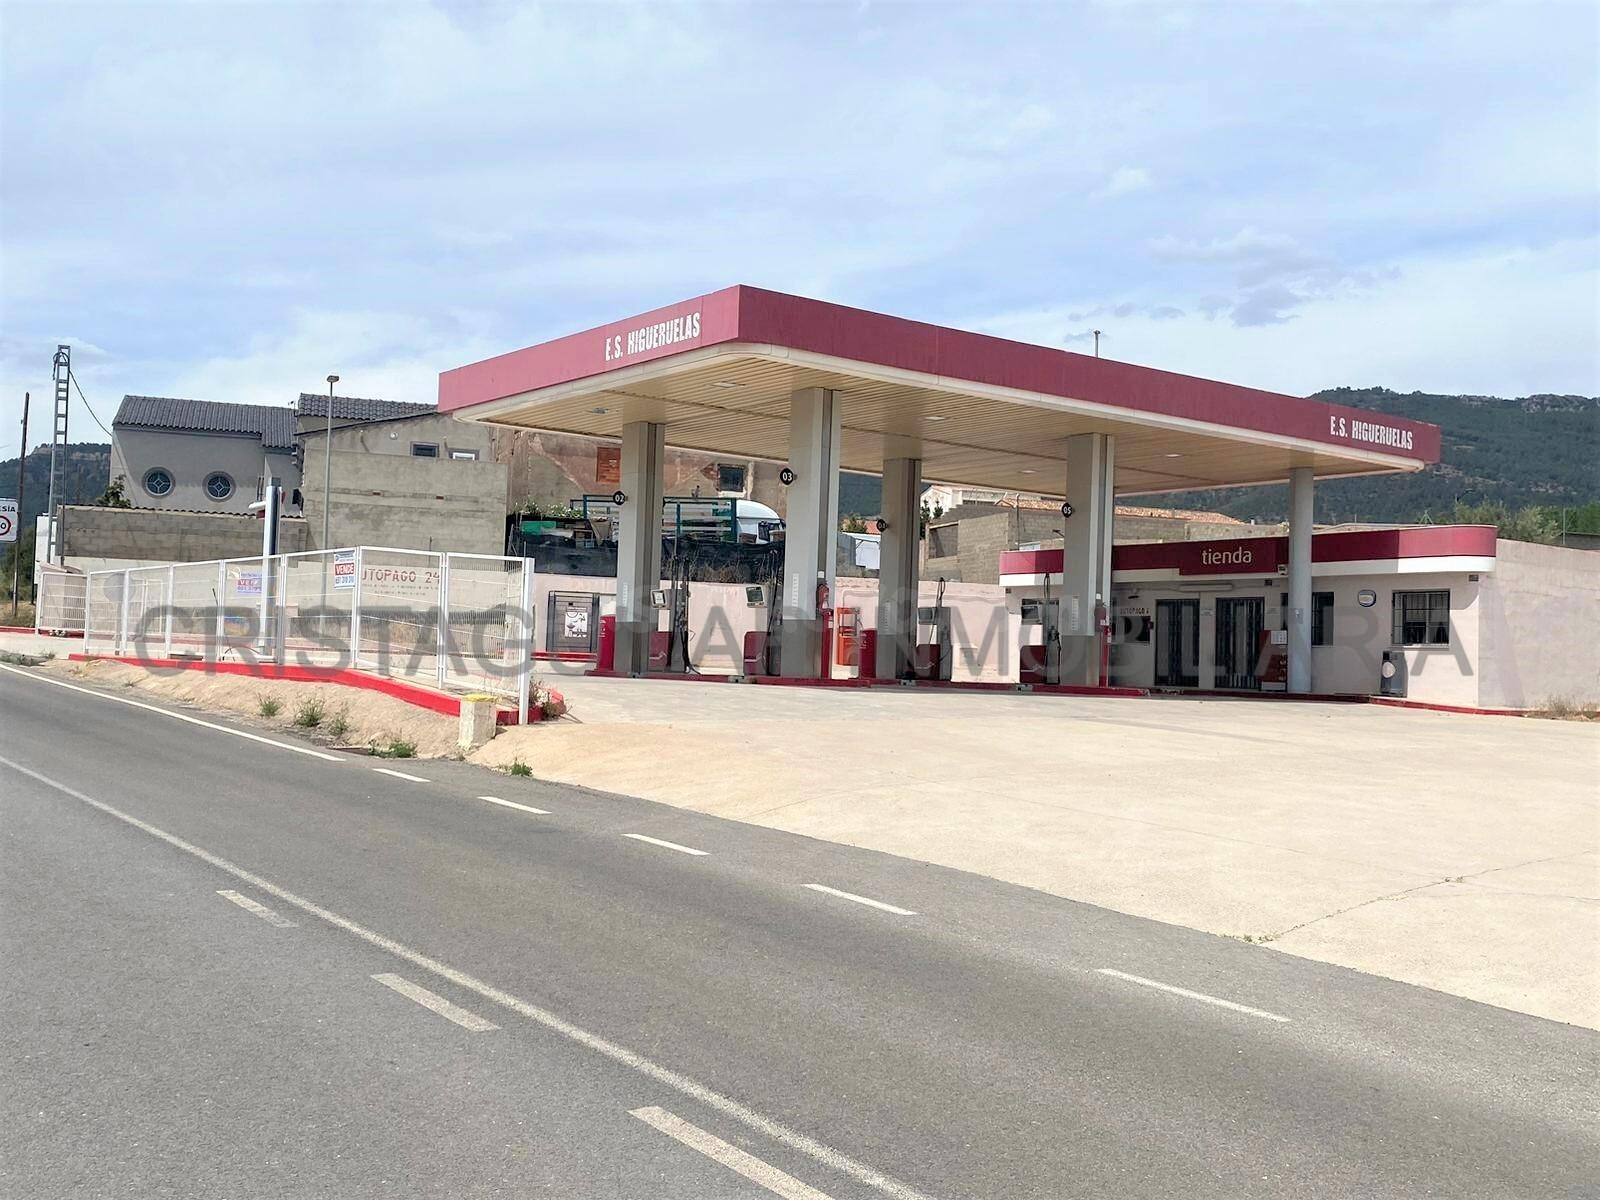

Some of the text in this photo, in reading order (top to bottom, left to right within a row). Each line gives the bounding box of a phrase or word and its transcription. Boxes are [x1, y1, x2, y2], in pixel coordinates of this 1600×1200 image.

[605, 312, 700, 361] E.S. HIGUERUELAS
[1330, 415, 1413, 450] E.S. HIGUERUELAS
[782, 471, 793, 482] 03
[615, 494, 625, 503] 02
[0, 504, 16, 512] SÍA
[1063, 506, 1072, 515] 05
[1202, 546, 1253, 565] tienda
